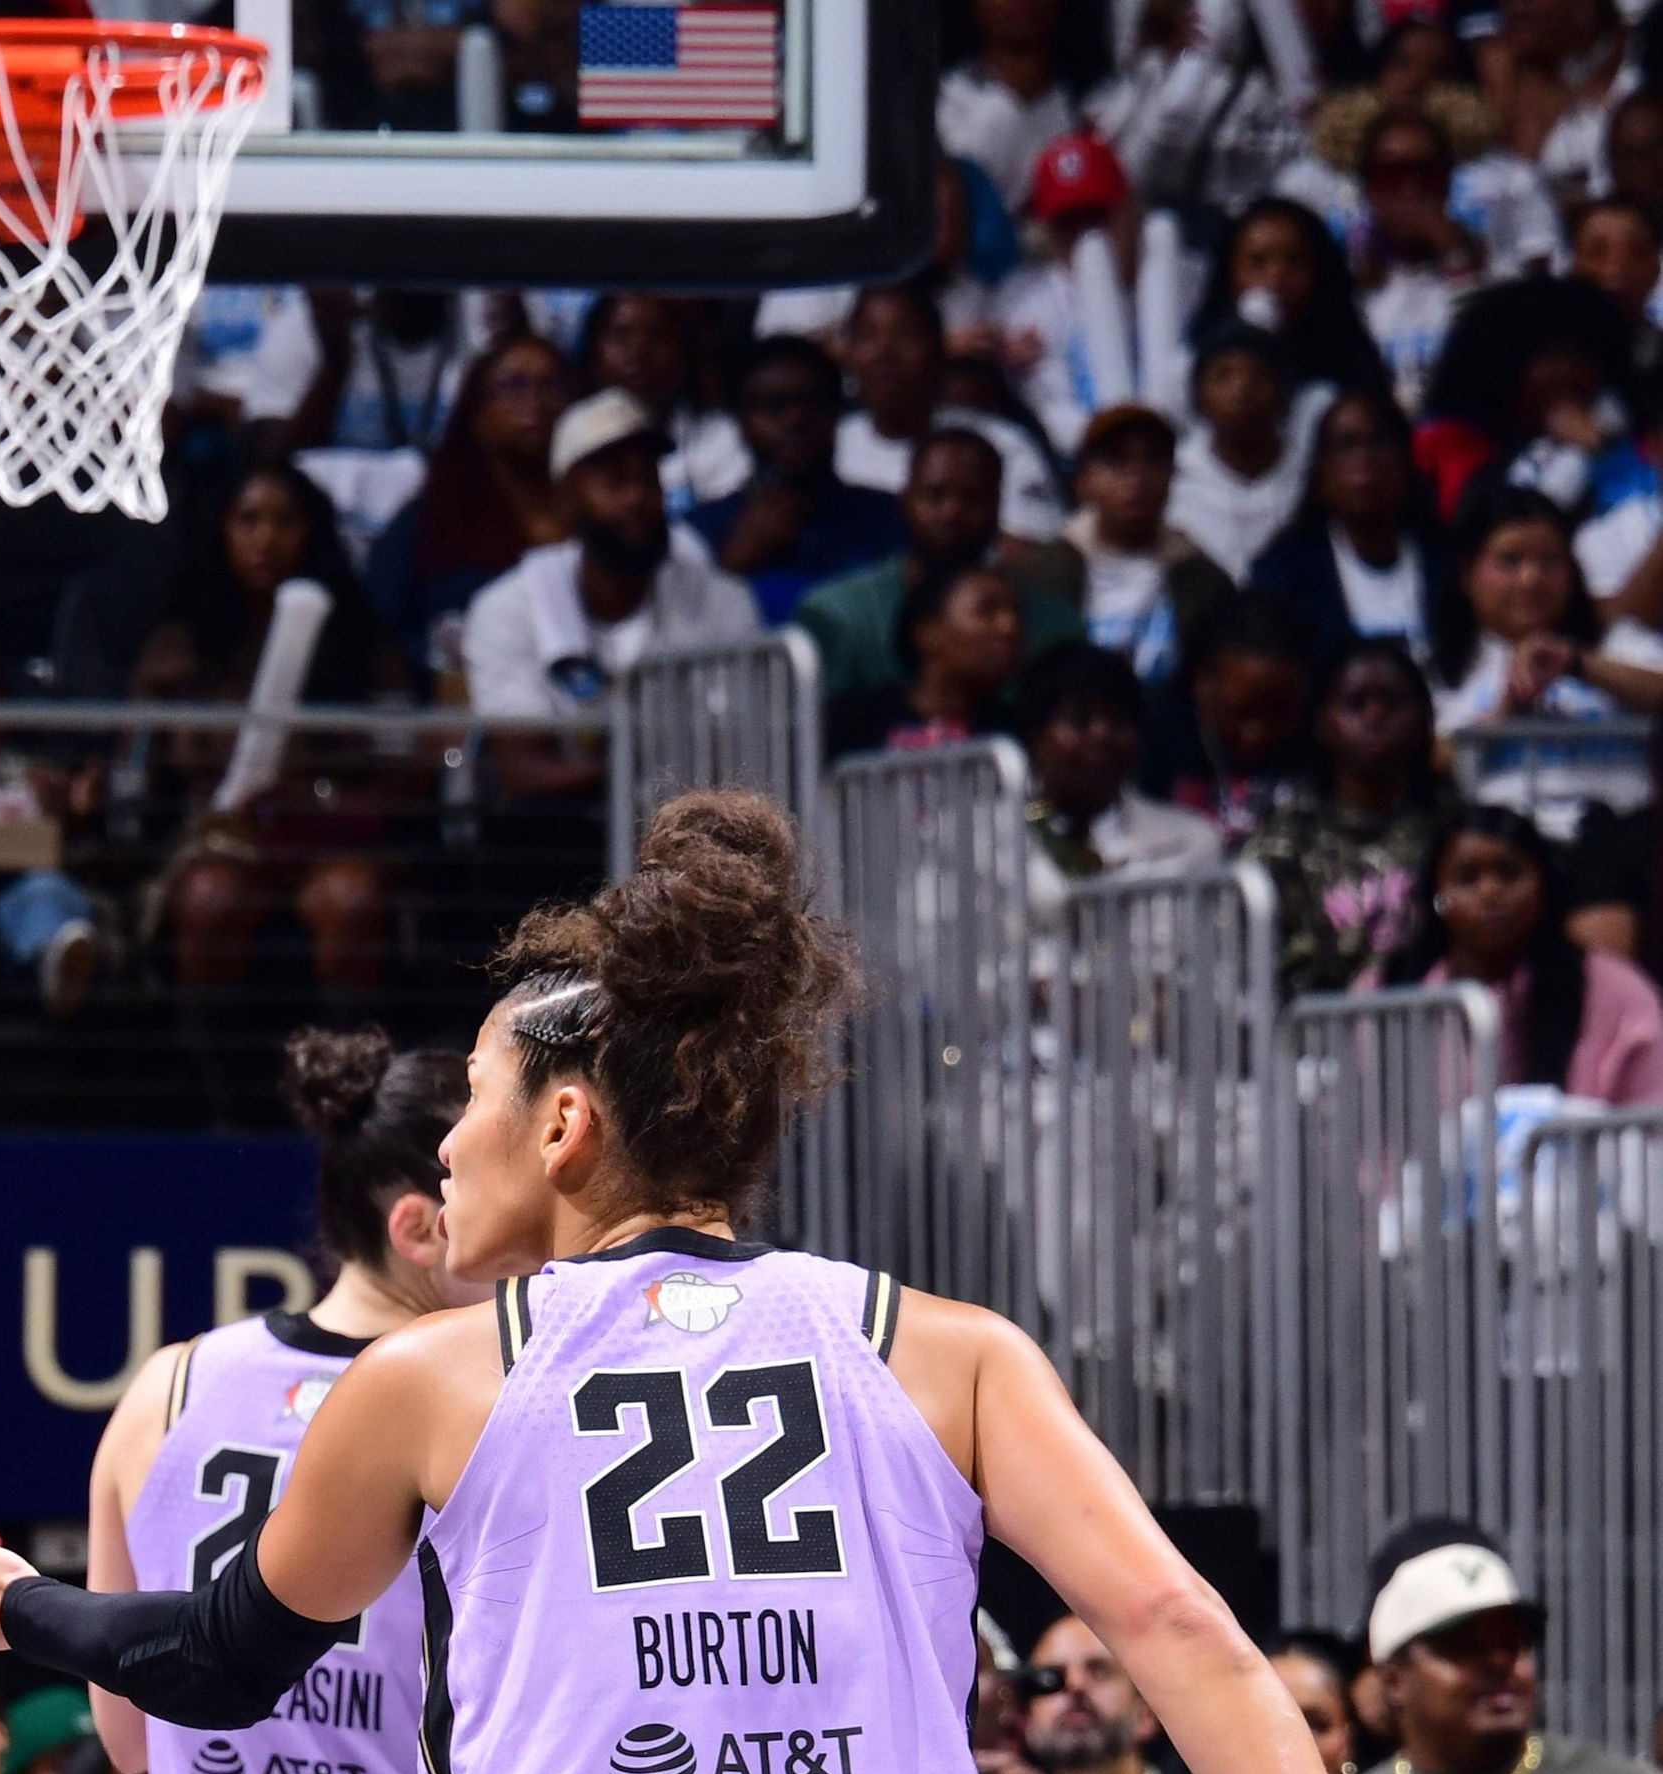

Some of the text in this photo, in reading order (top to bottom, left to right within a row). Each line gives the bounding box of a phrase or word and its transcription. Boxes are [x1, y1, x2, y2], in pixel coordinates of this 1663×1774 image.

[568, 1356, 848, 1594] 22
[633, 1609, 819, 1690] BURTON
[268, 1666, 383, 1732] ASINI
